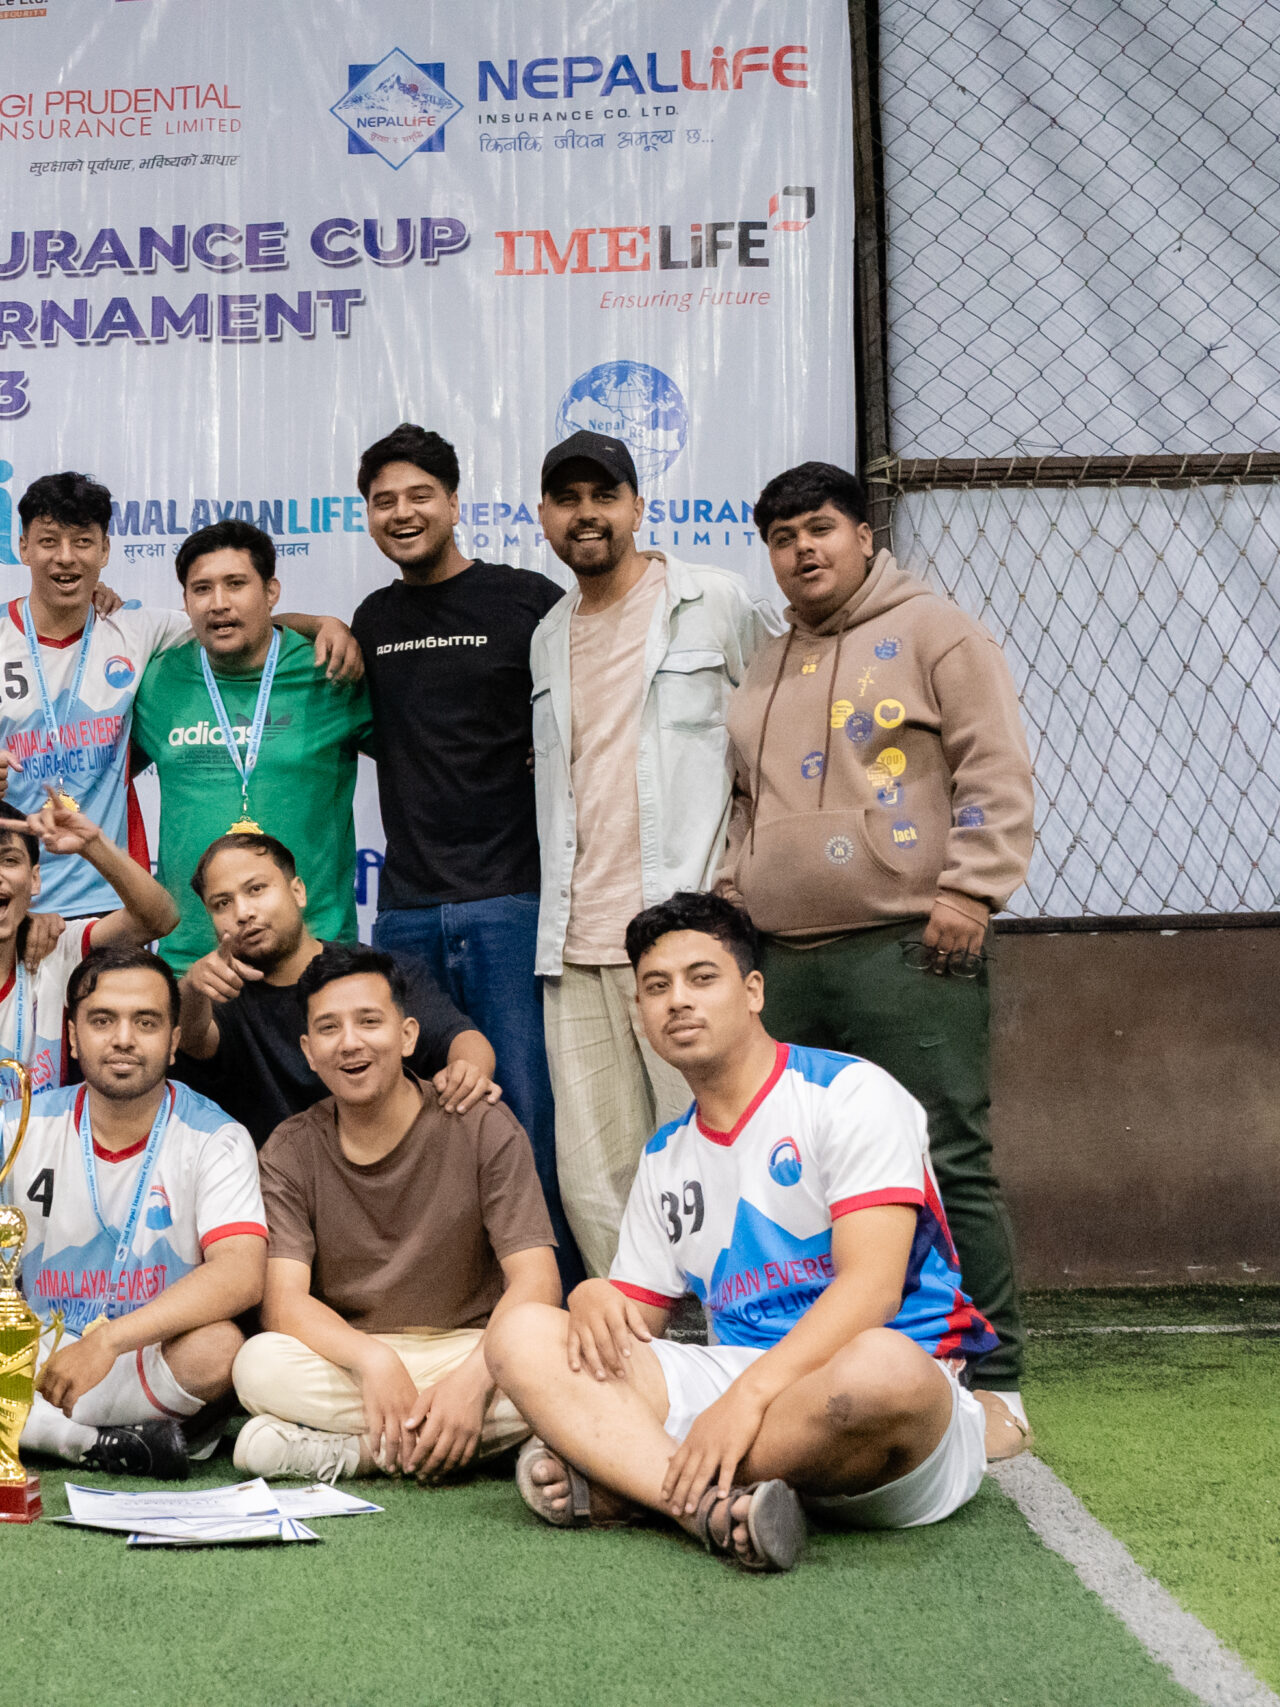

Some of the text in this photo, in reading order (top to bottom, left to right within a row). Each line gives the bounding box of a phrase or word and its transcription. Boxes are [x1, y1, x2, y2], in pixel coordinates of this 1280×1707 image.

[46, 83, 242, 117] PRUDENTIAL
[165, 119, 242, 136] LIMITED
[478, 105, 680, 125] INSURANCE CO. LTD.
[554, 129, 605, 150] जीवन
[617, 130, 675, 151] अमूल्य
[29, 158, 84, 177] सुरक्षाको
[138, 153, 198, 170] भविष्यको
[199, 153, 240, 167] आधार
[309, 216, 472, 270] CUP
[600, 286, 771, 313] Ensuring Future
[589, 418, 625, 432] Nepal
[647, 499, 755, 524] SURAN
[650, 530, 756, 546] LIMIT
[123, 543, 166, 563] सुरक्षा
[6, 722, 78, 758] HIMALAAN
[27, 1168, 54, 1218] 4
[132, 1170, 147, 1210] Insurance
[661, 1179, 705, 1245] 39
[763, 1253, 835, 1290] EVERE
